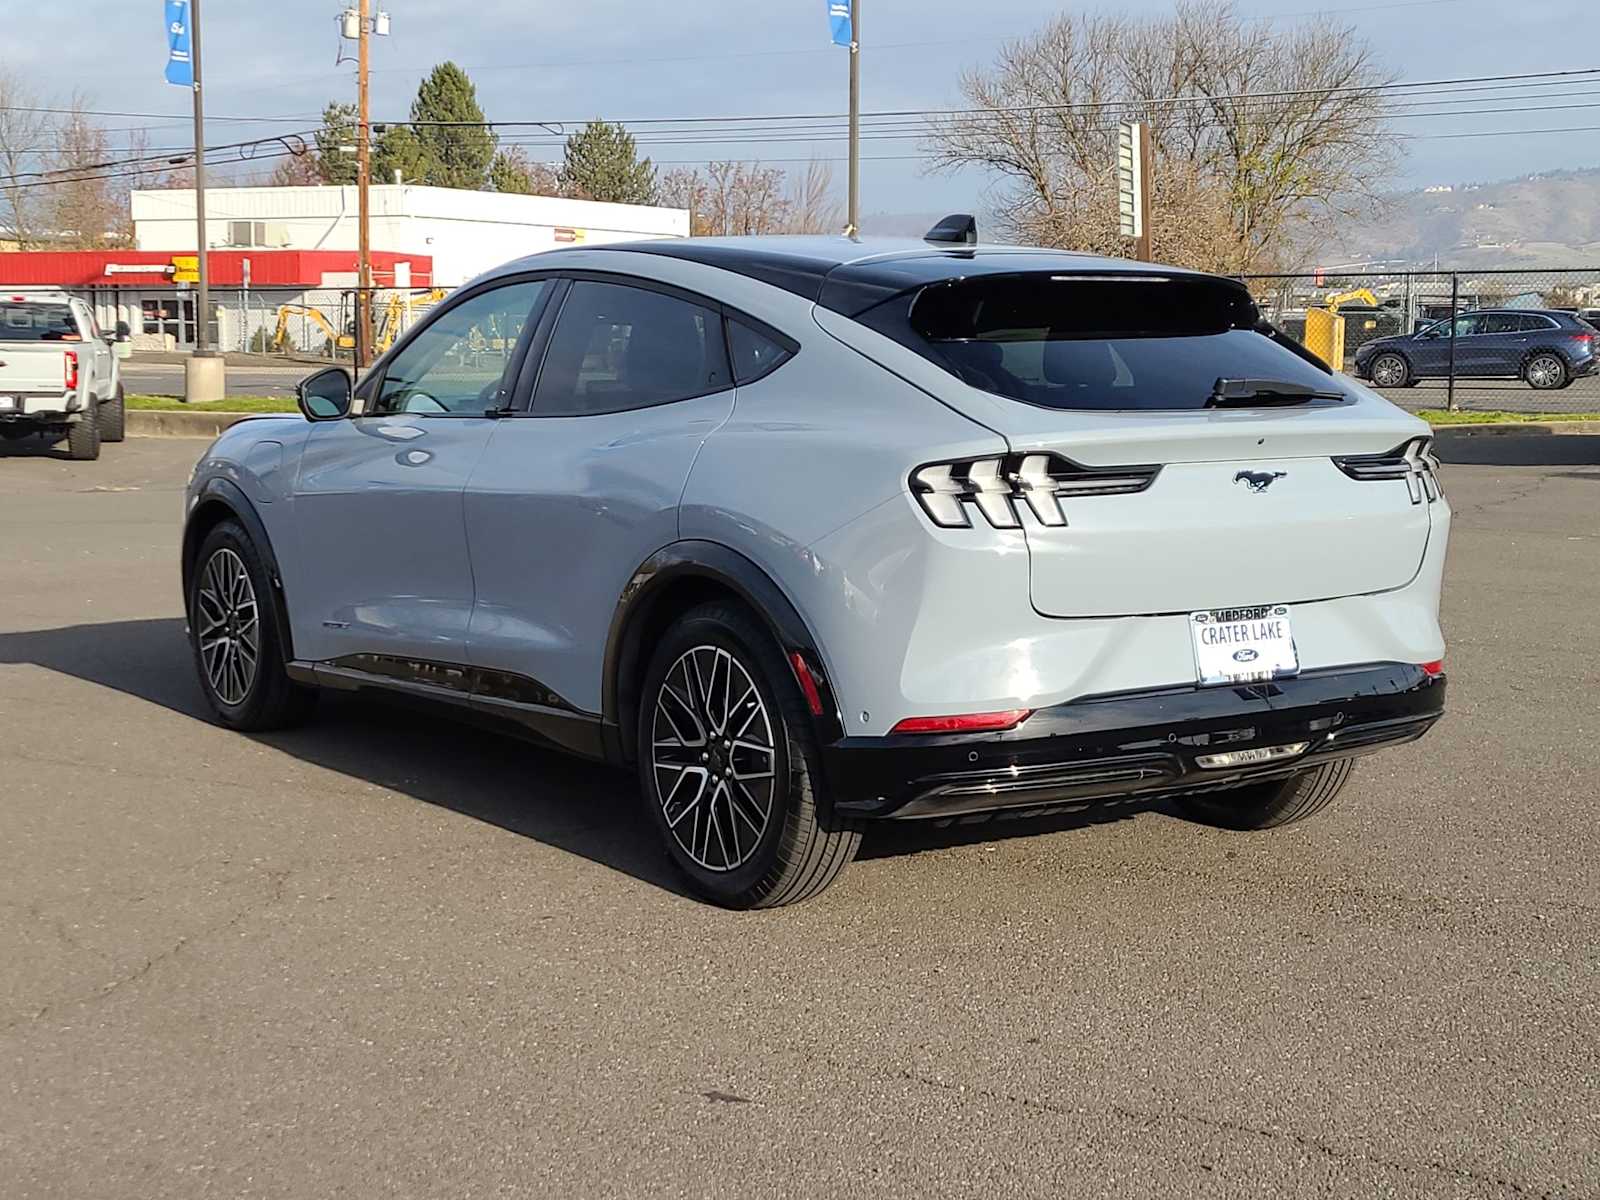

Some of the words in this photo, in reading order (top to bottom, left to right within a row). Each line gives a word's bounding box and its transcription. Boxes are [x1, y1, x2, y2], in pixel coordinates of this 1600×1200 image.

[1216, 608, 1267, 623] MEDFORD
[1201, 624, 1249, 645] CRATER
[1252, 621, 1283, 641] LAKE
